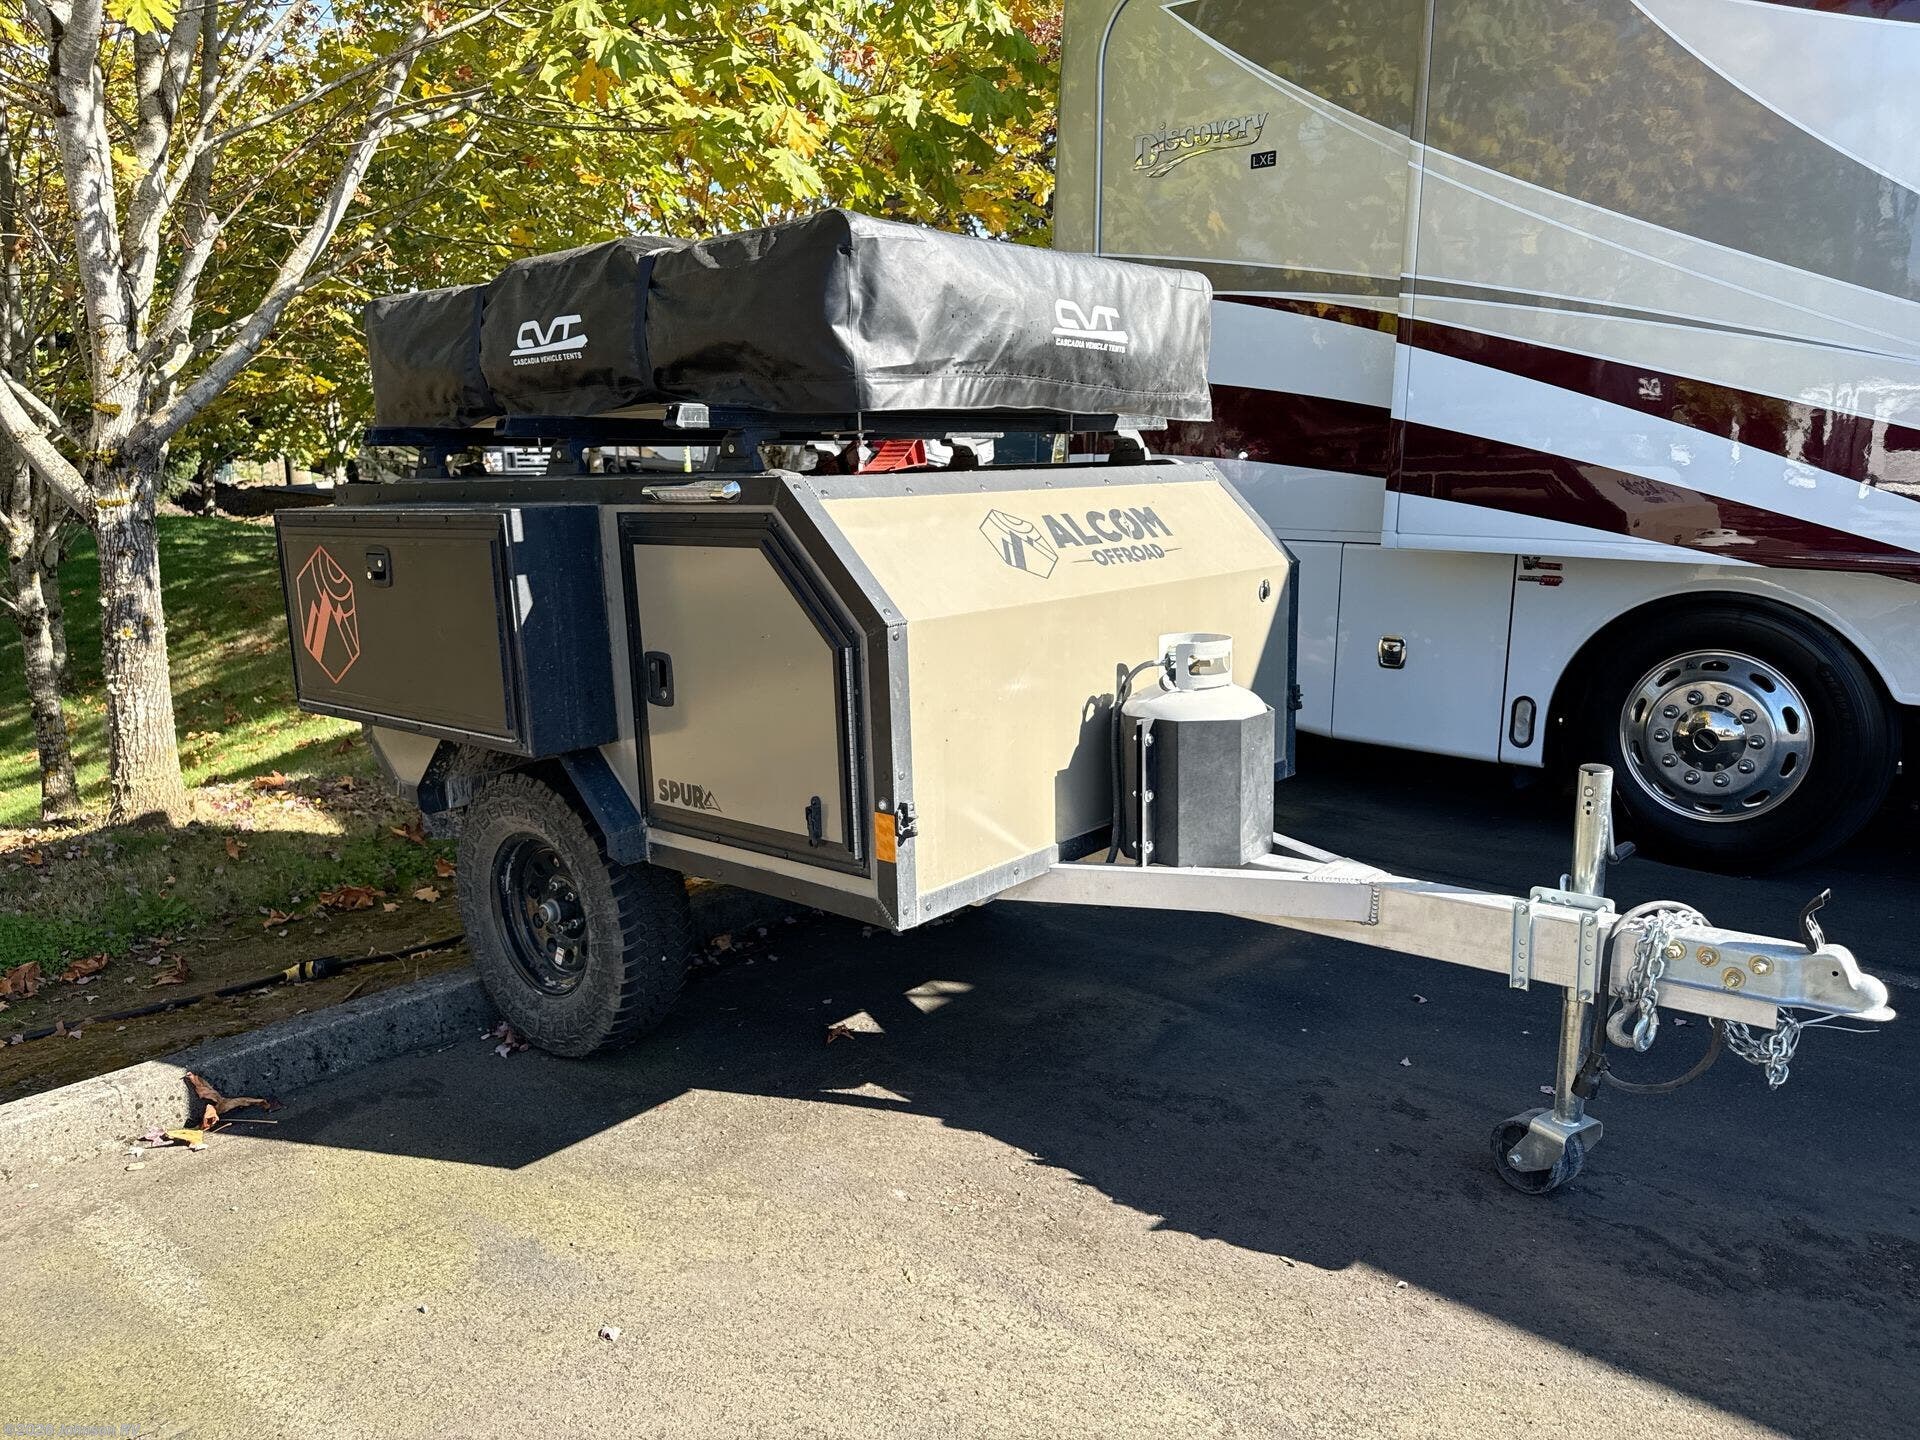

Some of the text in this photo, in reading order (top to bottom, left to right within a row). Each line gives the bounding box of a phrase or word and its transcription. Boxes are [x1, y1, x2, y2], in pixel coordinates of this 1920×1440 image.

[1133, 112, 1269, 171] Discovery
[1252, 152, 1275, 168] LXE
[1055, 298, 1120, 331] CVT
[517, 314, 582, 349] CVT
[513, 351, 583, 366] CASCADIA VEHICLE TENTS
[1055, 338, 1126, 354] CASCADIA VEHICLE TENTS
[1041, 506, 1174, 548] ALCOM
[1092, 543, 1165, 566] OFFROAD
